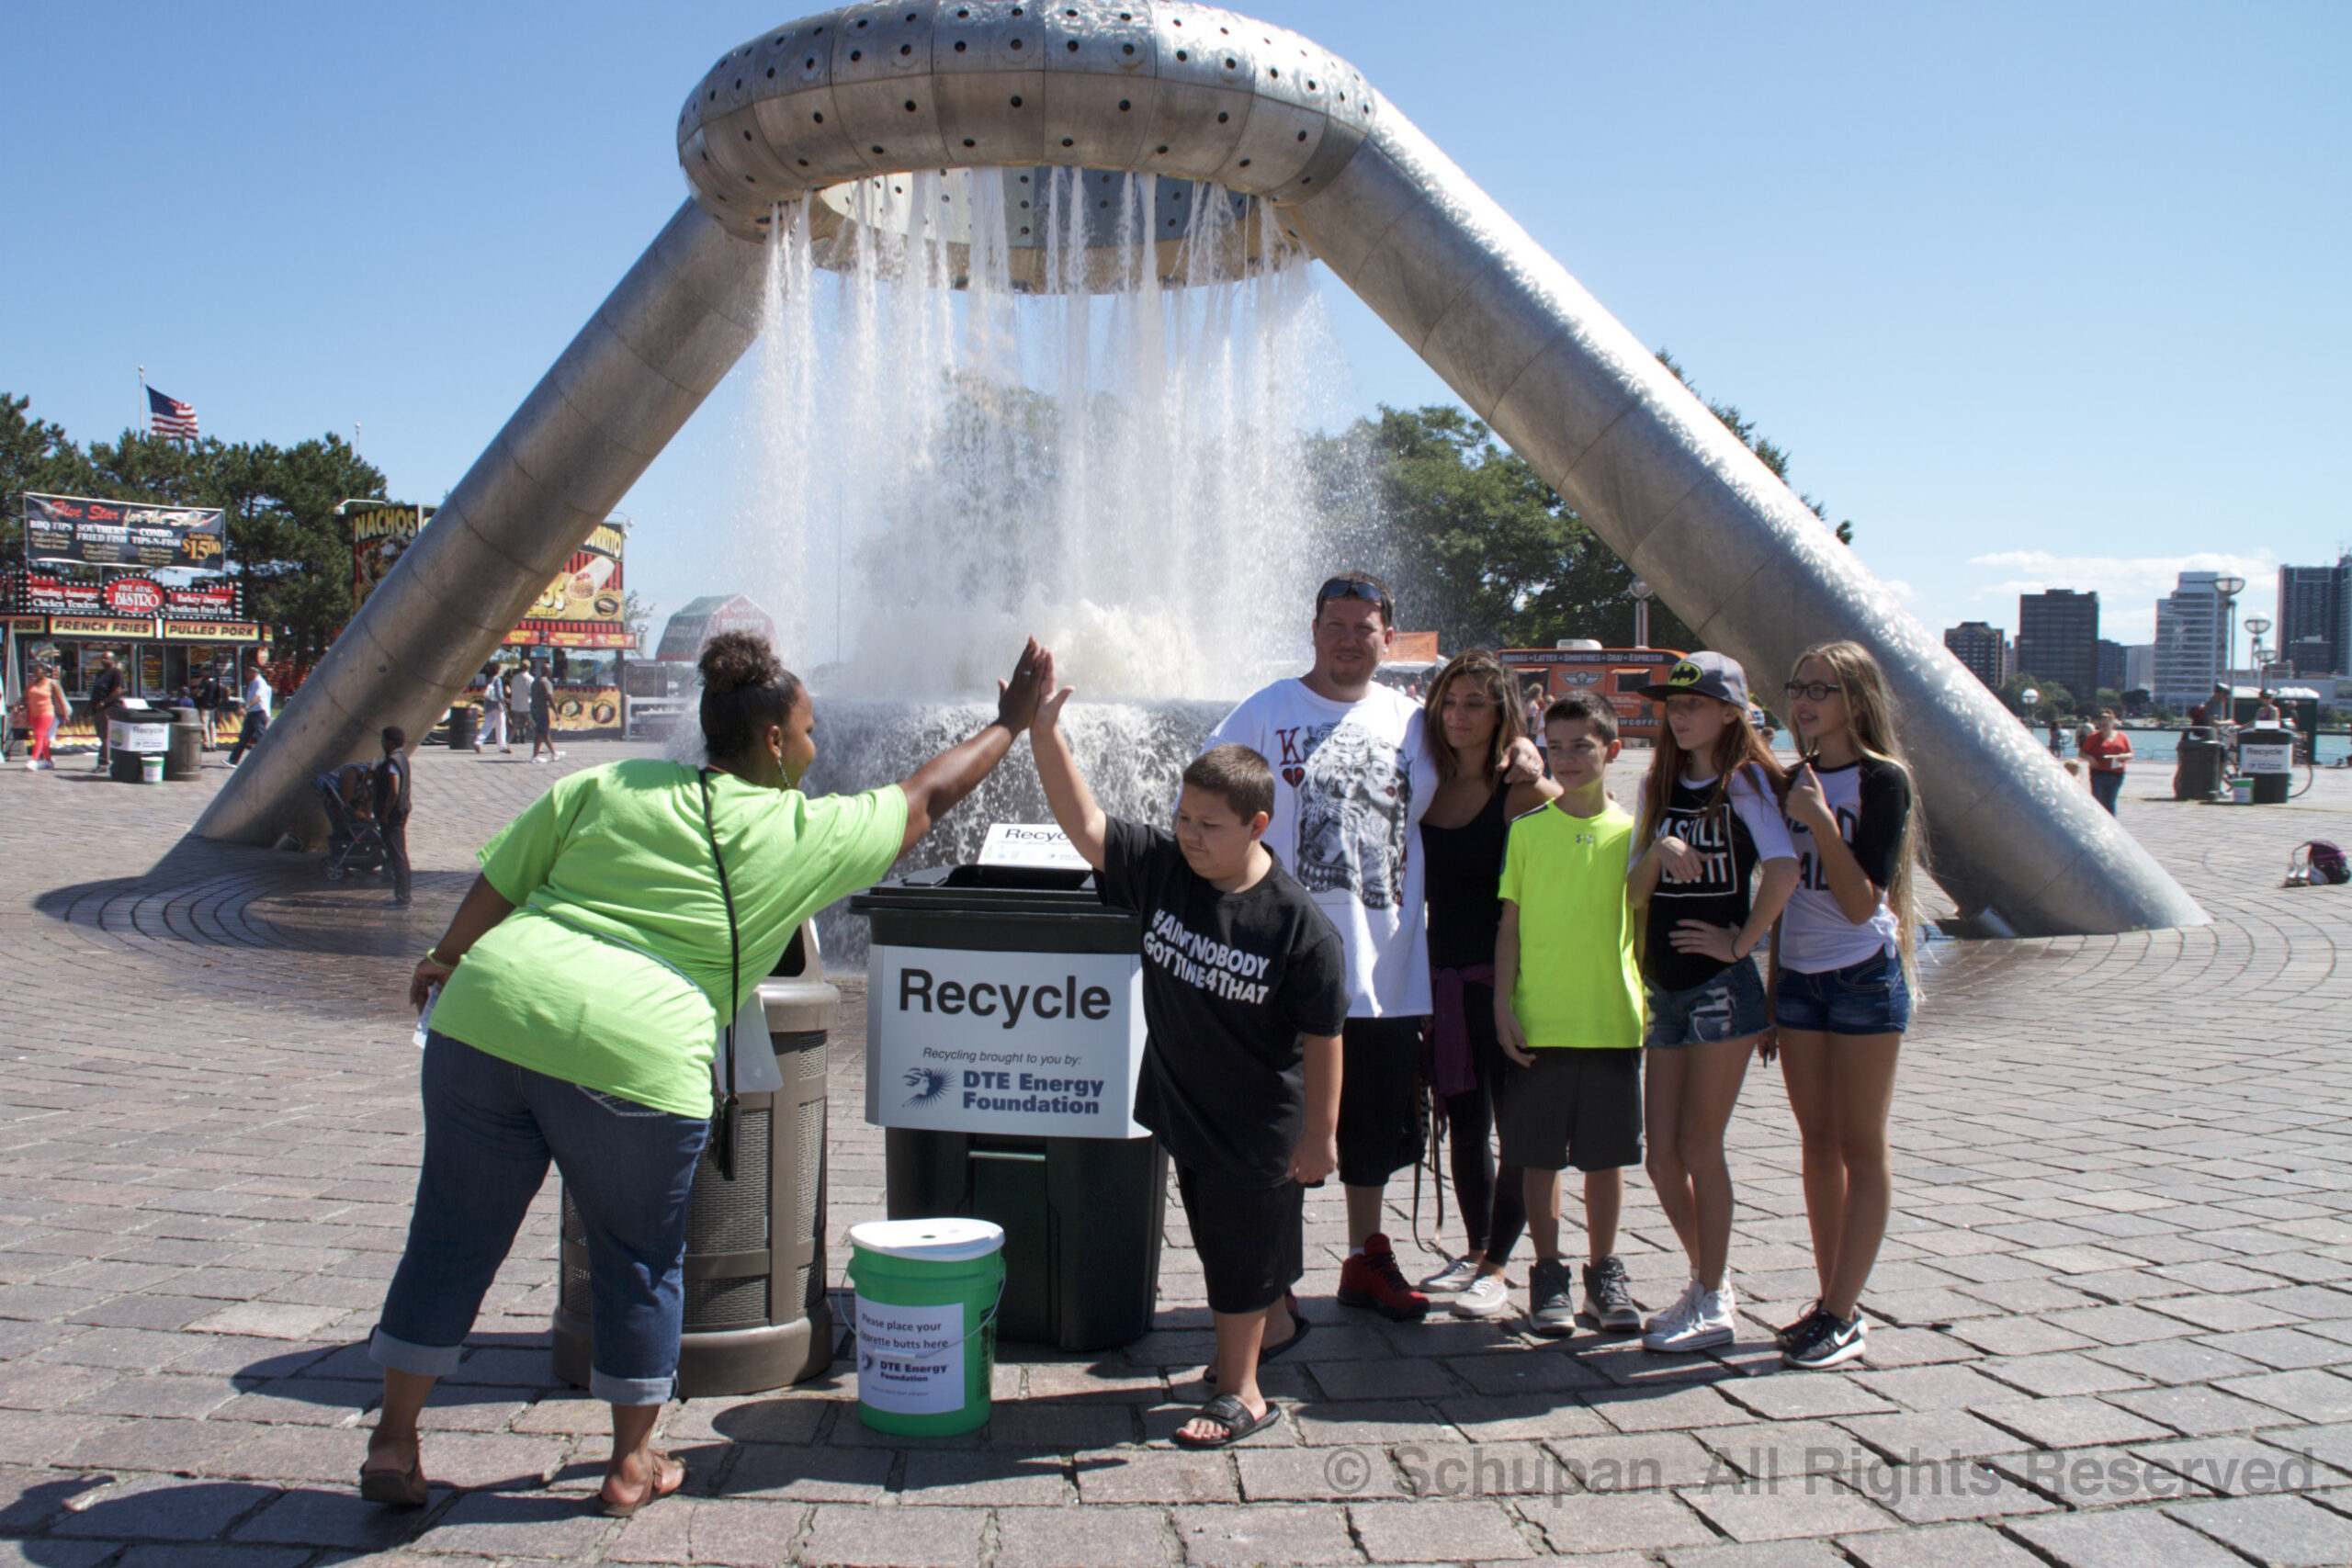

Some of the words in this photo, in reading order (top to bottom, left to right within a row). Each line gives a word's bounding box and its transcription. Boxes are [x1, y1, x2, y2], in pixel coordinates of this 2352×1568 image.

[86, 504, 119, 521] Star
[52, 522, 73, 531] TIPS
[139, 528, 173, 537] COMBO
[354, 508, 417, 543] NACHOS
[76, 533, 105, 542] FRIED
[107, 535, 128, 543] FISH
[584, 525, 622, 558] URRITO
[115, 592, 159, 607] BISTRO
[55, 620, 107, 631] FRENCH
[112, 622, 150, 633] FRIES
[169, 626, 216, 635] PULLED
[220, 626, 254, 636] PORK
[132, 726, 164, 735] Recycle
[1276, 727, 1304, 766] K
[1005, 829, 1069, 842] Recyc
[899, 968, 1112, 1030] Recycle
[922, 1047, 977, 1062] Recycling
[979, 1051, 1023, 1066] brought
[1026, 1053, 1037, 1064] to
[1039, 1056, 1061, 1066] you
[1064, 1055, 1082, 1067] by:
[963, 1070, 1011, 1090] DTE
[1019, 1073, 1104, 1098] Energy
[963, 1091, 1100, 1114] Foundation
[862, 1313, 885, 1328] Please
[887, 1321, 913, 1331] place
[917, 1322, 942, 1333] your
[893, 1338, 921, 1349] butts
[923, 1339, 949, 1349] here
[880, 1360, 901, 1372] DTE
[905, 1363, 947, 1374] Energy
[880, 1371, 929, 1382] Foundation
